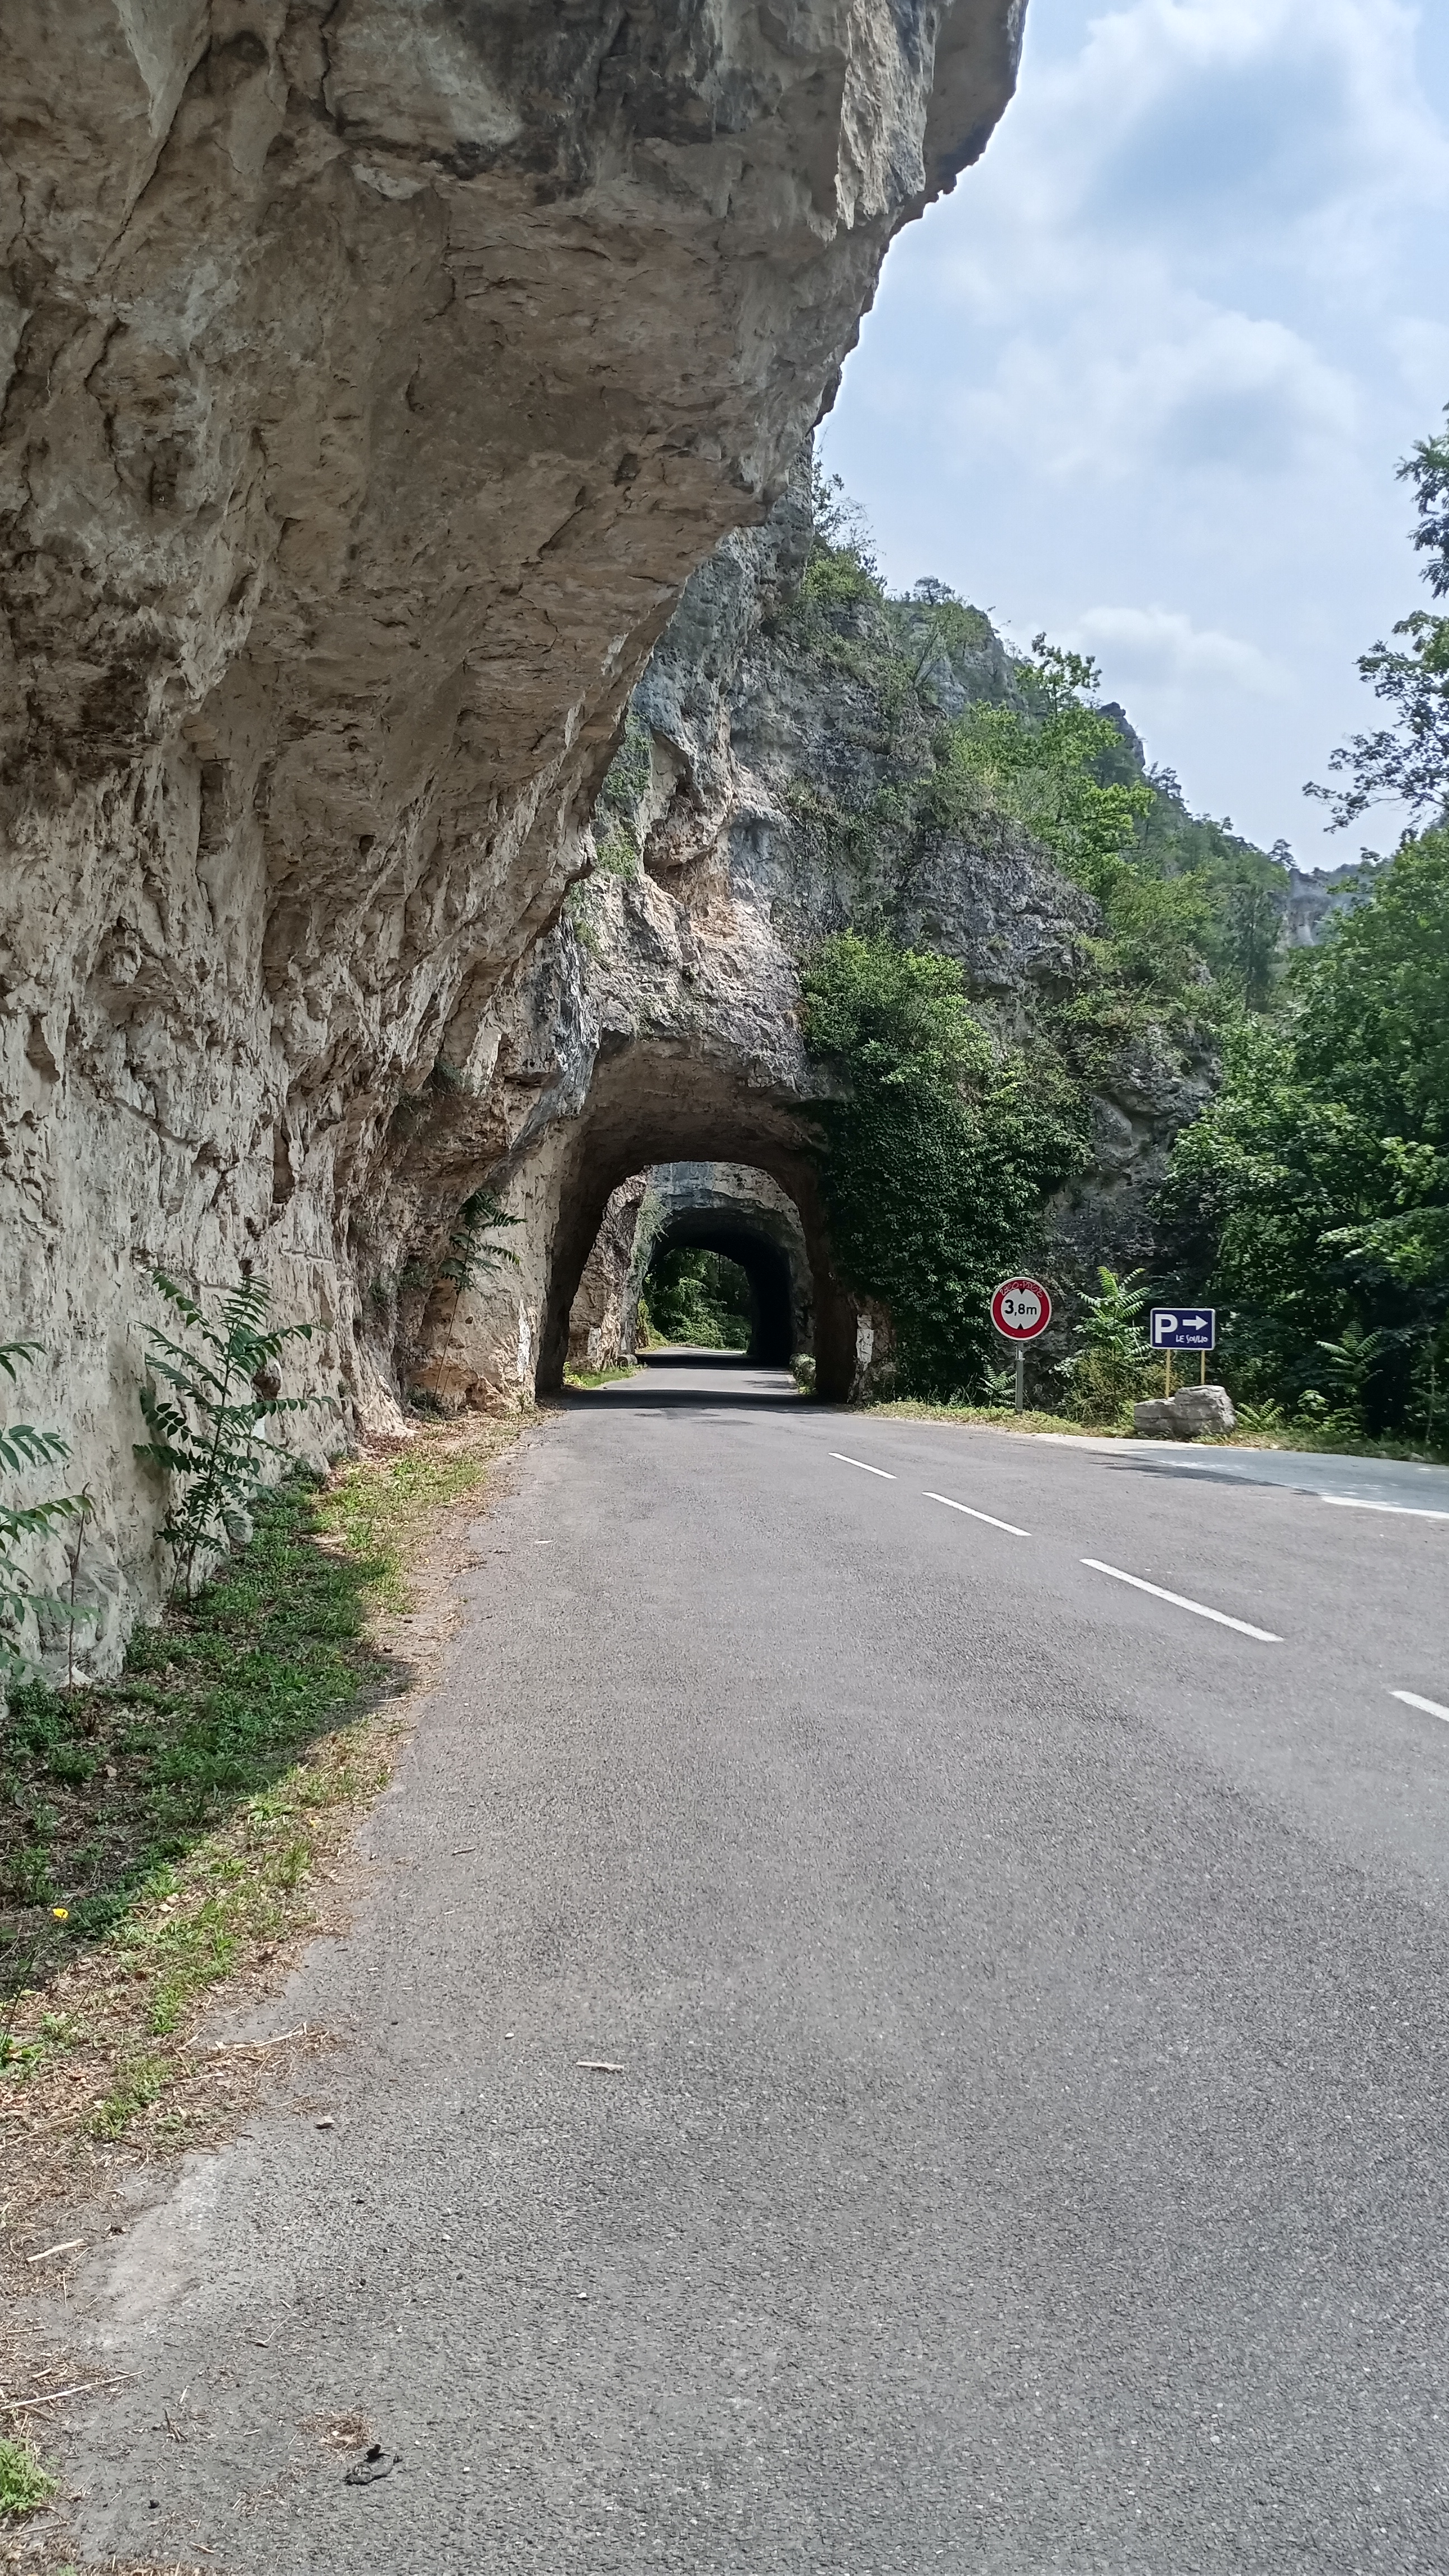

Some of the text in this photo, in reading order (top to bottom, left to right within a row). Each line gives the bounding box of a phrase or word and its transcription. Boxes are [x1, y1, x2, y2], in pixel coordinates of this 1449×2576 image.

[1005, 1299, 1037, 1316] 3,8m
[1155, 1314, 1178, 1343] P
[1176, 1334, 1185, 1343] LE
